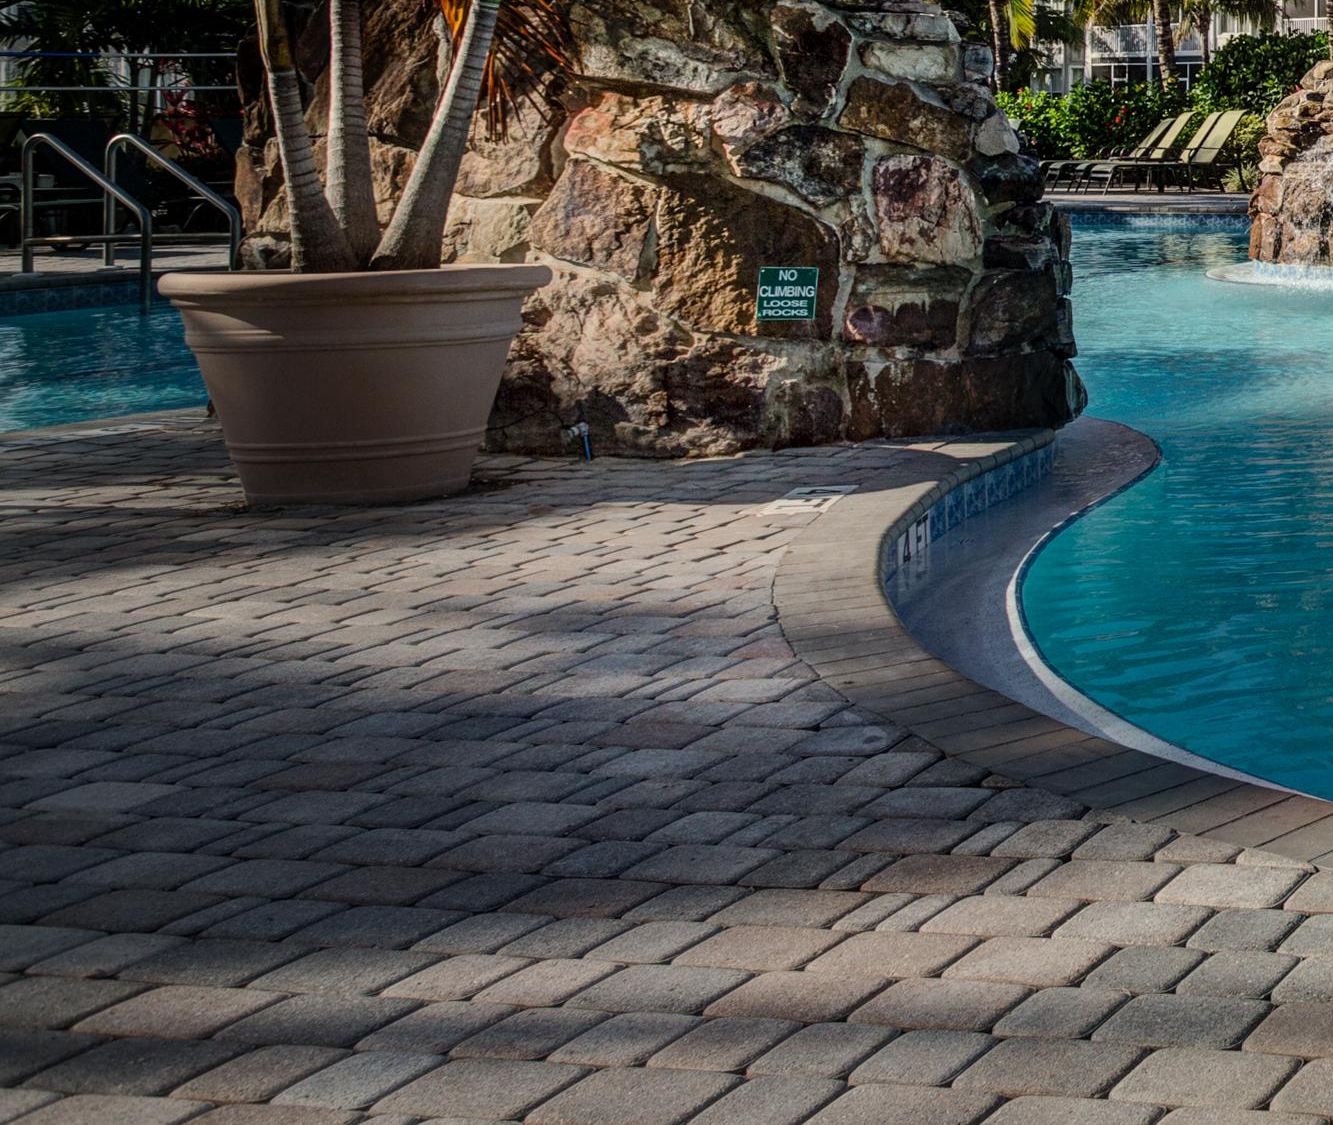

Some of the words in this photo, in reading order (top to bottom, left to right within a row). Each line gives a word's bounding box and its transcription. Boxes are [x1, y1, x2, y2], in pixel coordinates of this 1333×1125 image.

[778, 269, 798, 281] NO
[760, 285, 815, 298] CLIMBING
[763, 299, 808, 307] LOOSE
[762, 308, 808, 316] ROCKS
[903, 528, 912, 563] 4
[915, 513, 928, 555] FT
